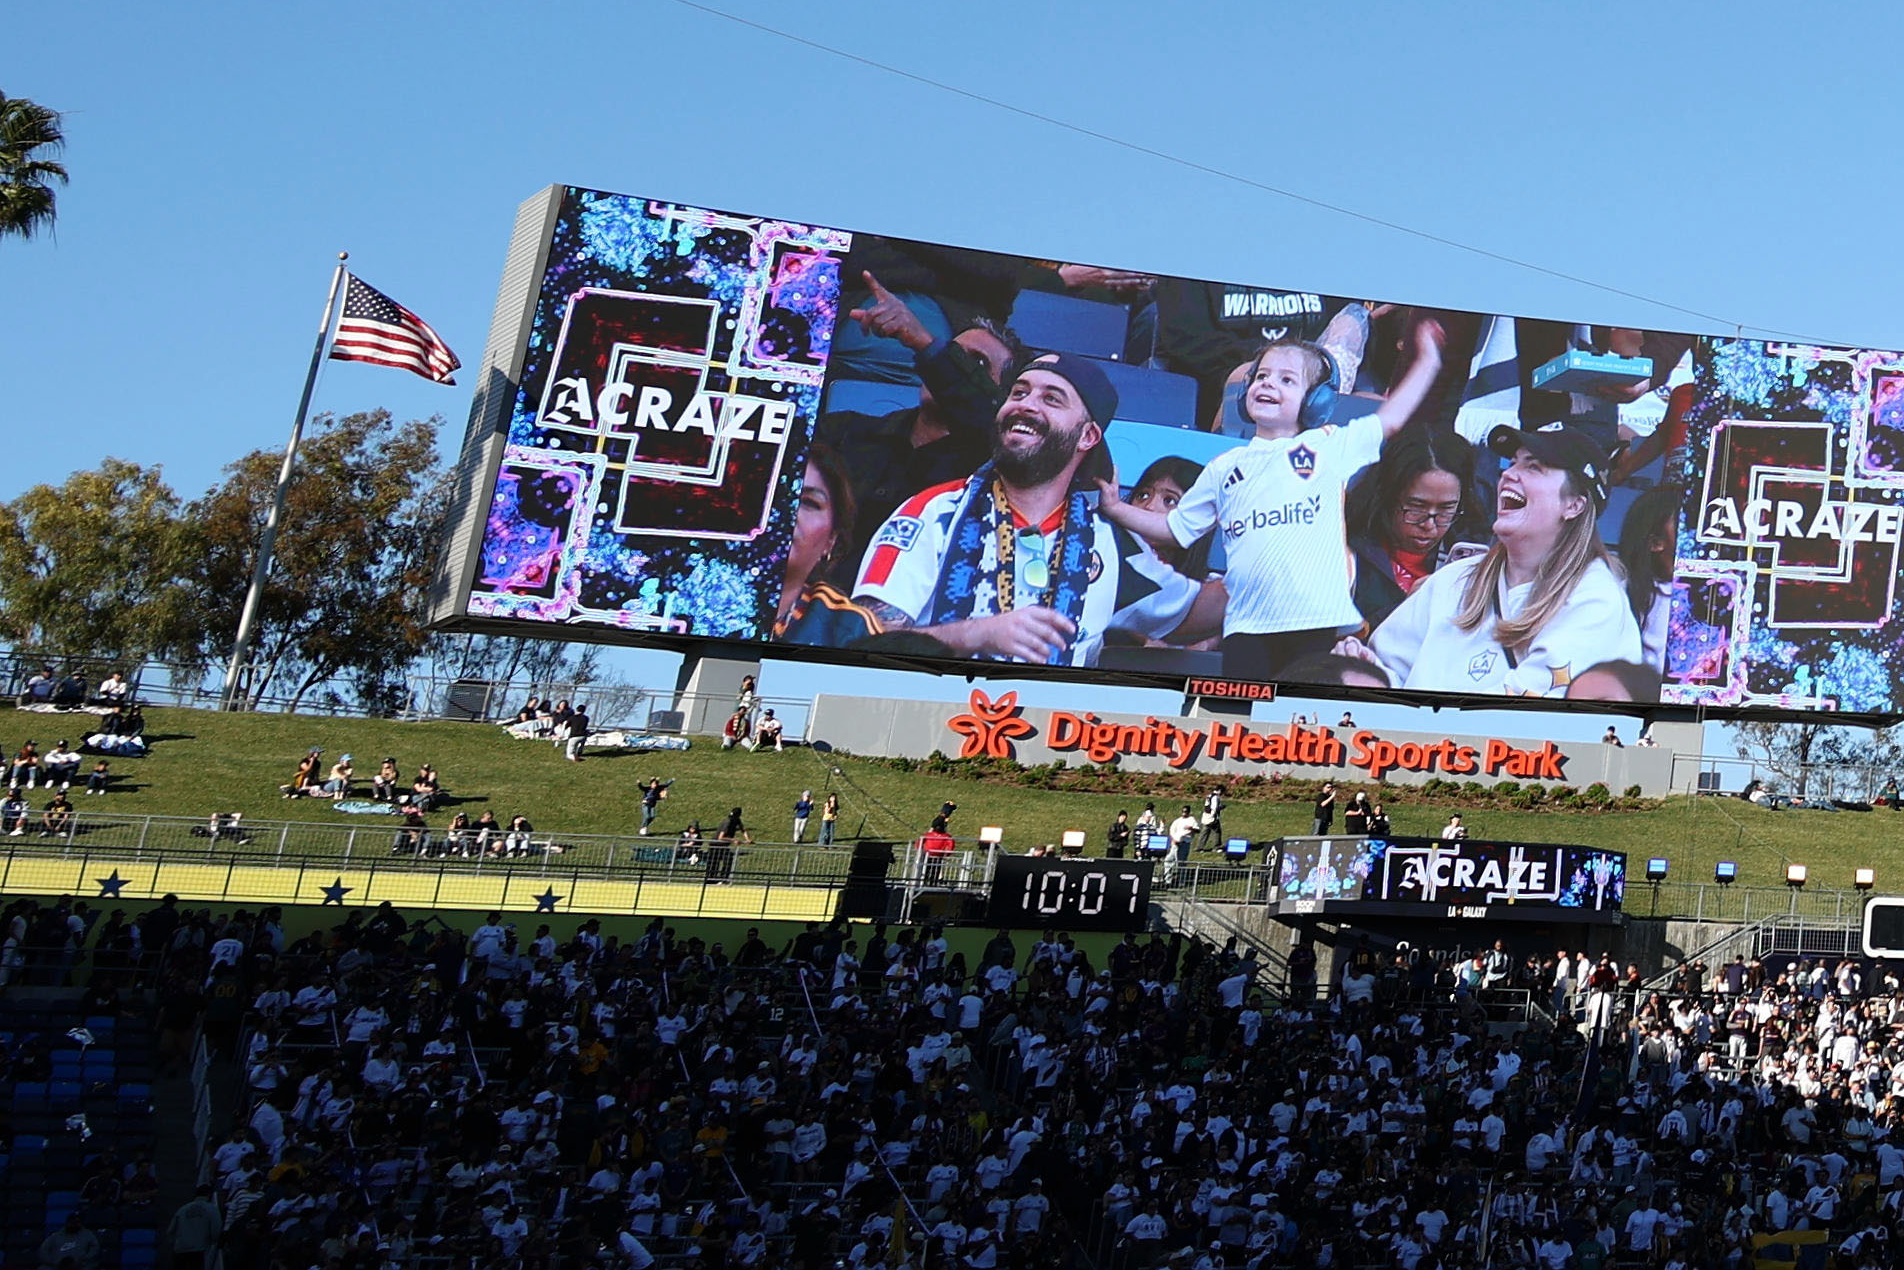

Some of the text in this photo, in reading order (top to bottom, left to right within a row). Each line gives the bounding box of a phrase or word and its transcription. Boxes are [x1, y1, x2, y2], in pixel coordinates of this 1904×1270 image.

[544, 376, 789, 444] ACRAZE
[1294, 457, 1312, 468] LA
[1224, 502, 1314, 541] Herbalife
[1703, 497, 1899, 543] ACRAZE
[1473, 659, 1489, 668] LA
[1189, 679, 1274, 700] TOSHIBA
[1047, 710, 1565, 779] Dignity Health Sports Park
[1398, 857, 1547, 890] ACRAZE
[1022, 871, 1140, 915] 10:07
[1448, 906, 1487, 917] LA GALAXY
[223, 946, 236, 958] 21
[769, 1007, 784, 1022] 12
